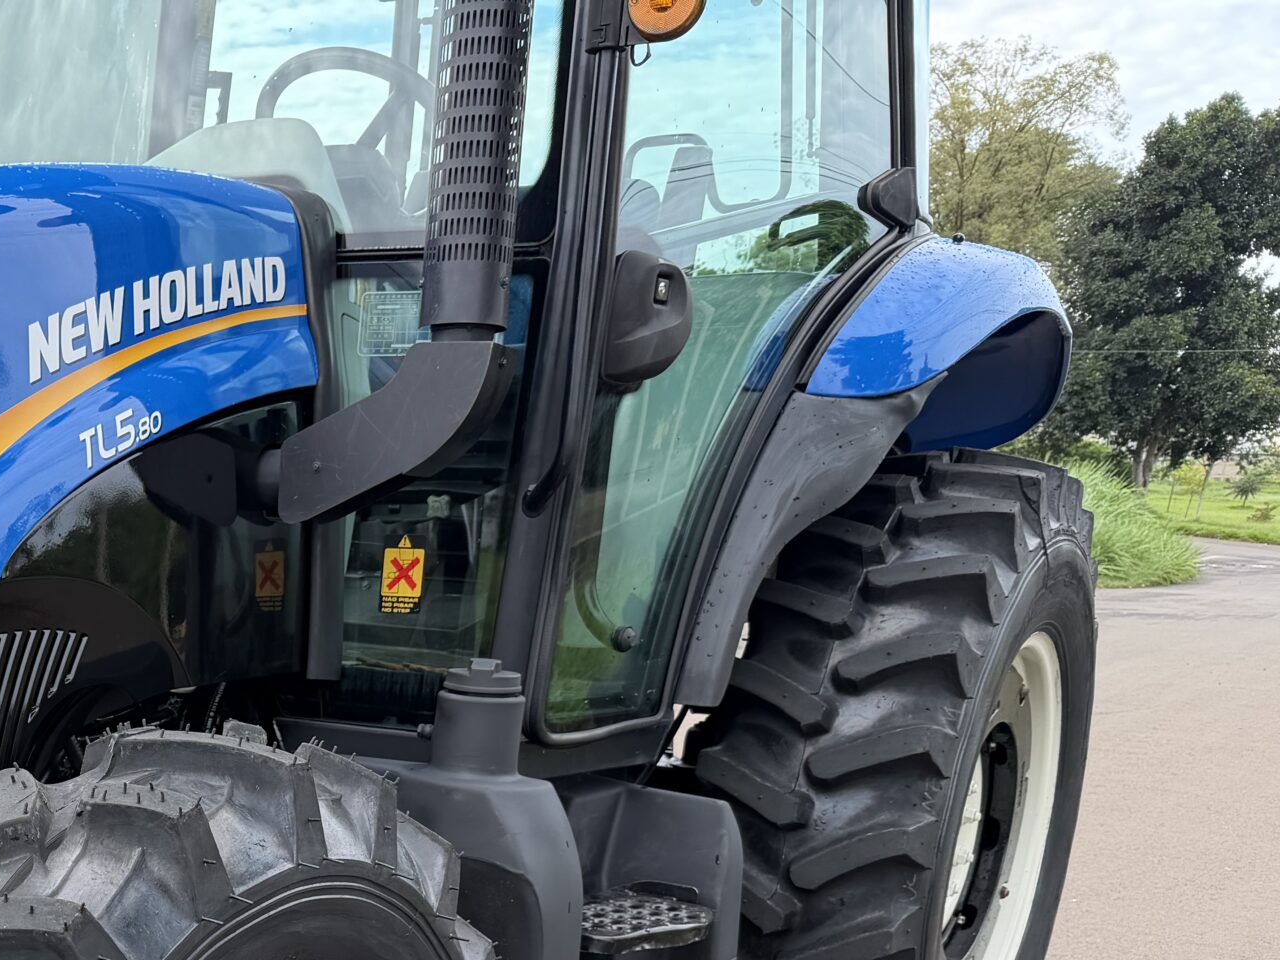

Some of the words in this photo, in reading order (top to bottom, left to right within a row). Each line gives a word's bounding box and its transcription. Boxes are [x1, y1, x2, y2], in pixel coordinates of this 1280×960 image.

[28, 286, 125, 385] NEW
[132, 256, 286, 337] HOLLAND
[79, 408, 162, 470] TL5.80
